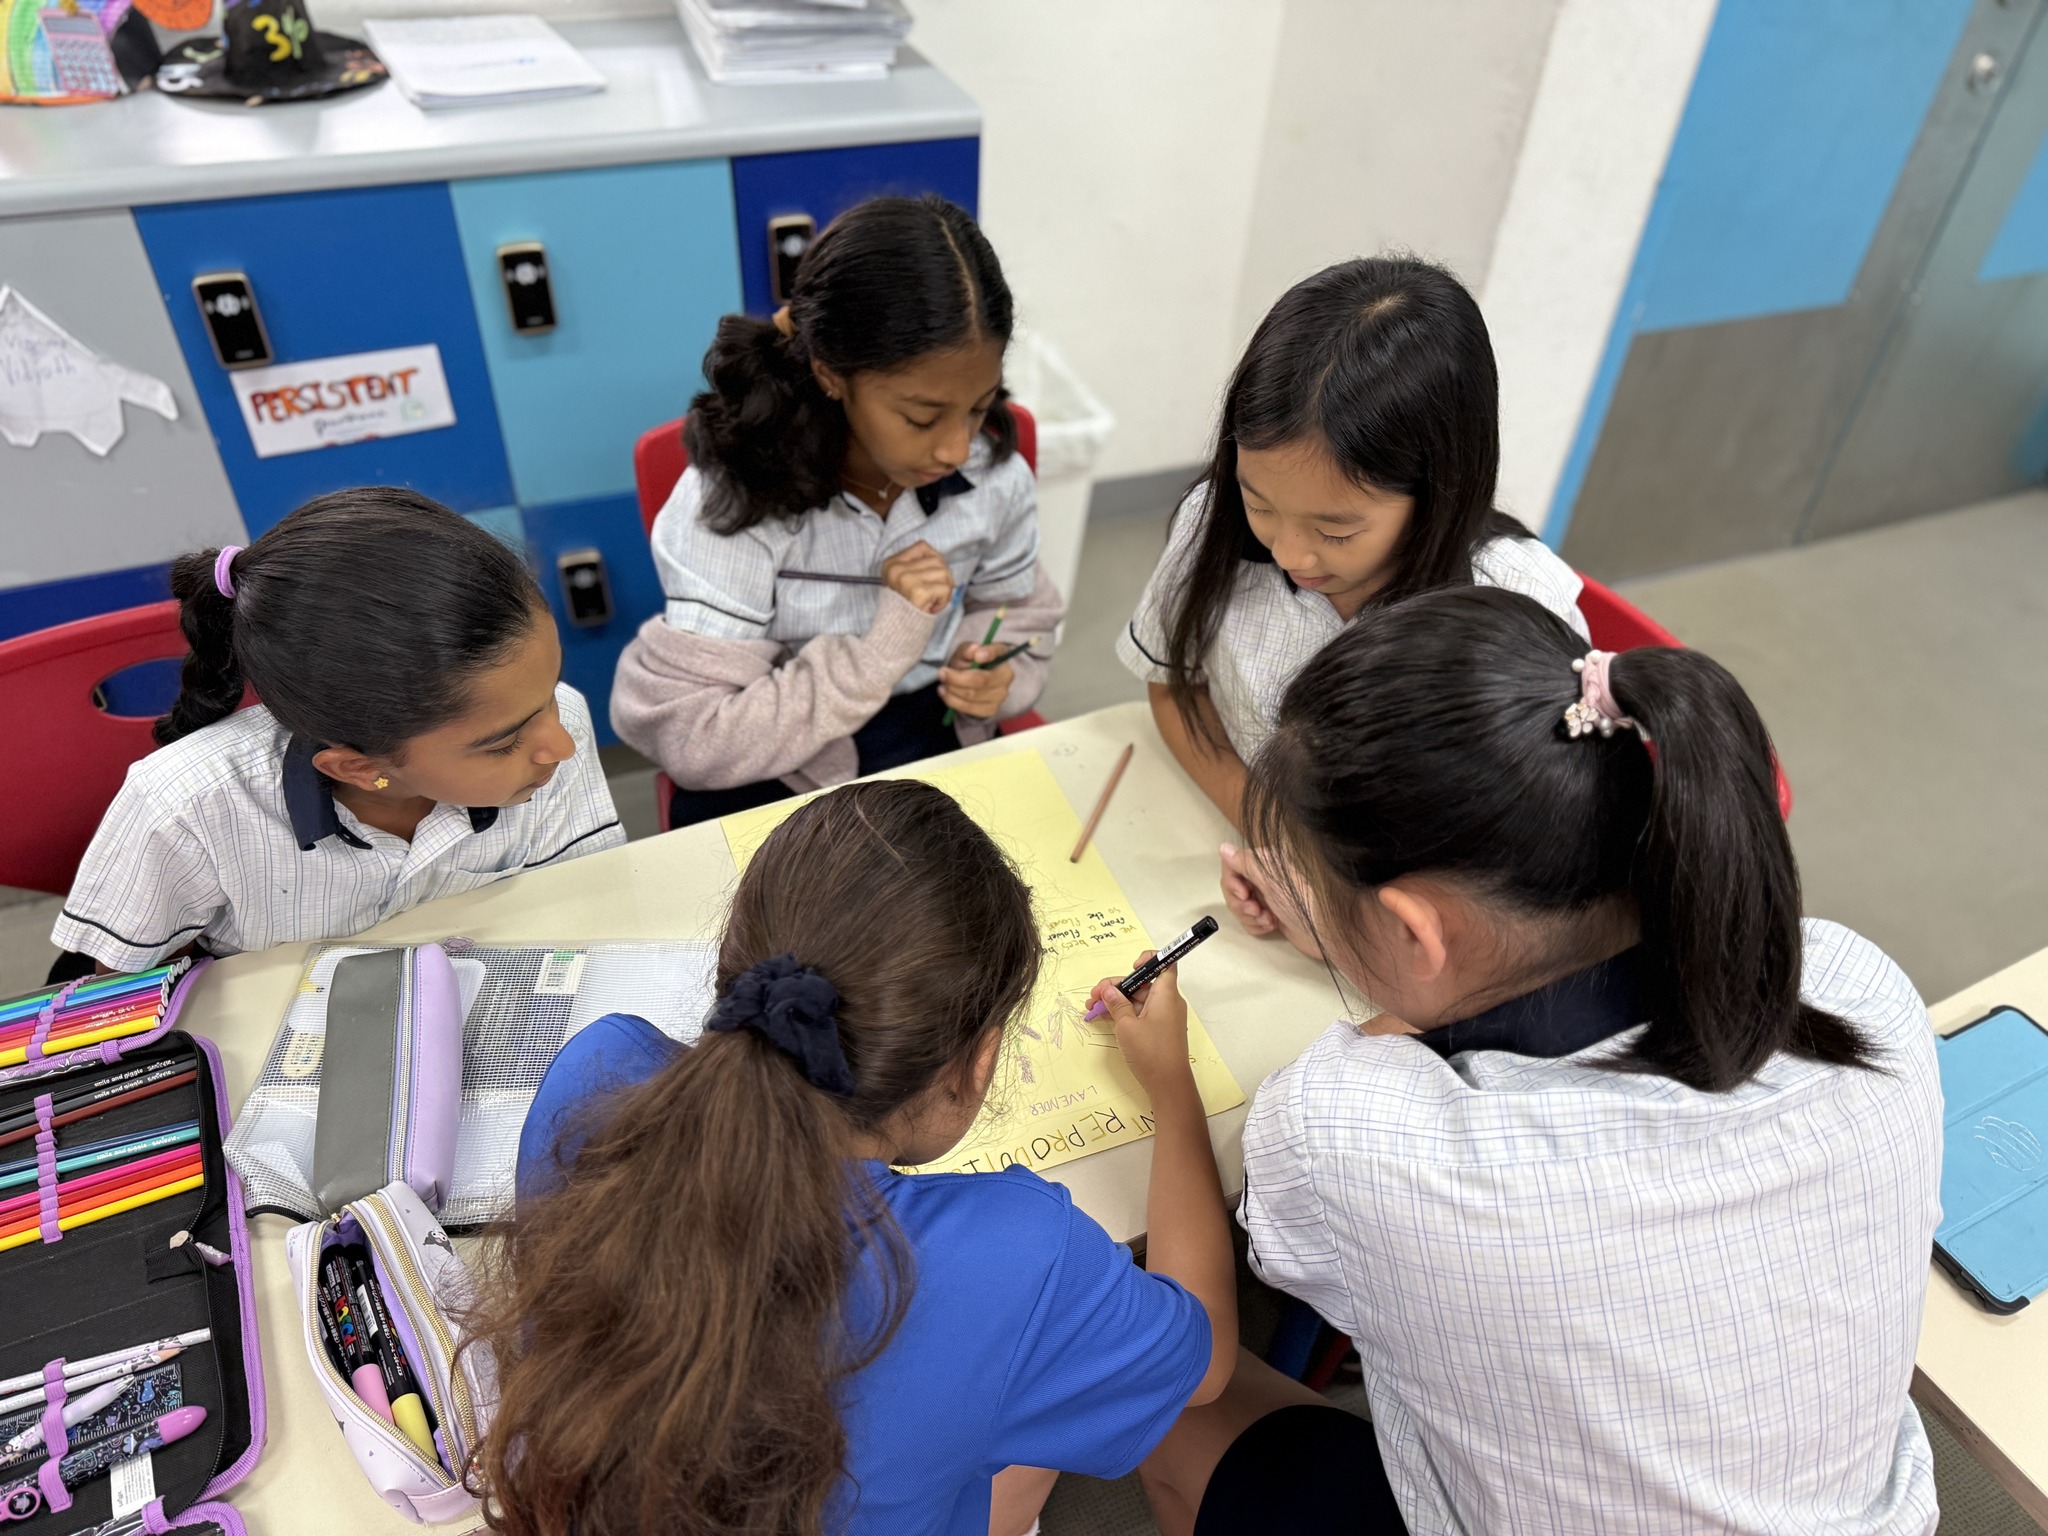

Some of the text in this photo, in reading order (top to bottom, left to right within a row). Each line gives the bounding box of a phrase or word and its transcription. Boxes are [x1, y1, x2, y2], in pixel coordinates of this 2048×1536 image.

[1087, 911, 1105, 921] the
[1100, 917, 1126, 928] from
[1047, 928, 1081, 941] flower
[1090, 931, 1117, 944] need
[1030, 1084, 1099, 1117] LAVENDER
[334, 1295, 357, 1349] POSCA
